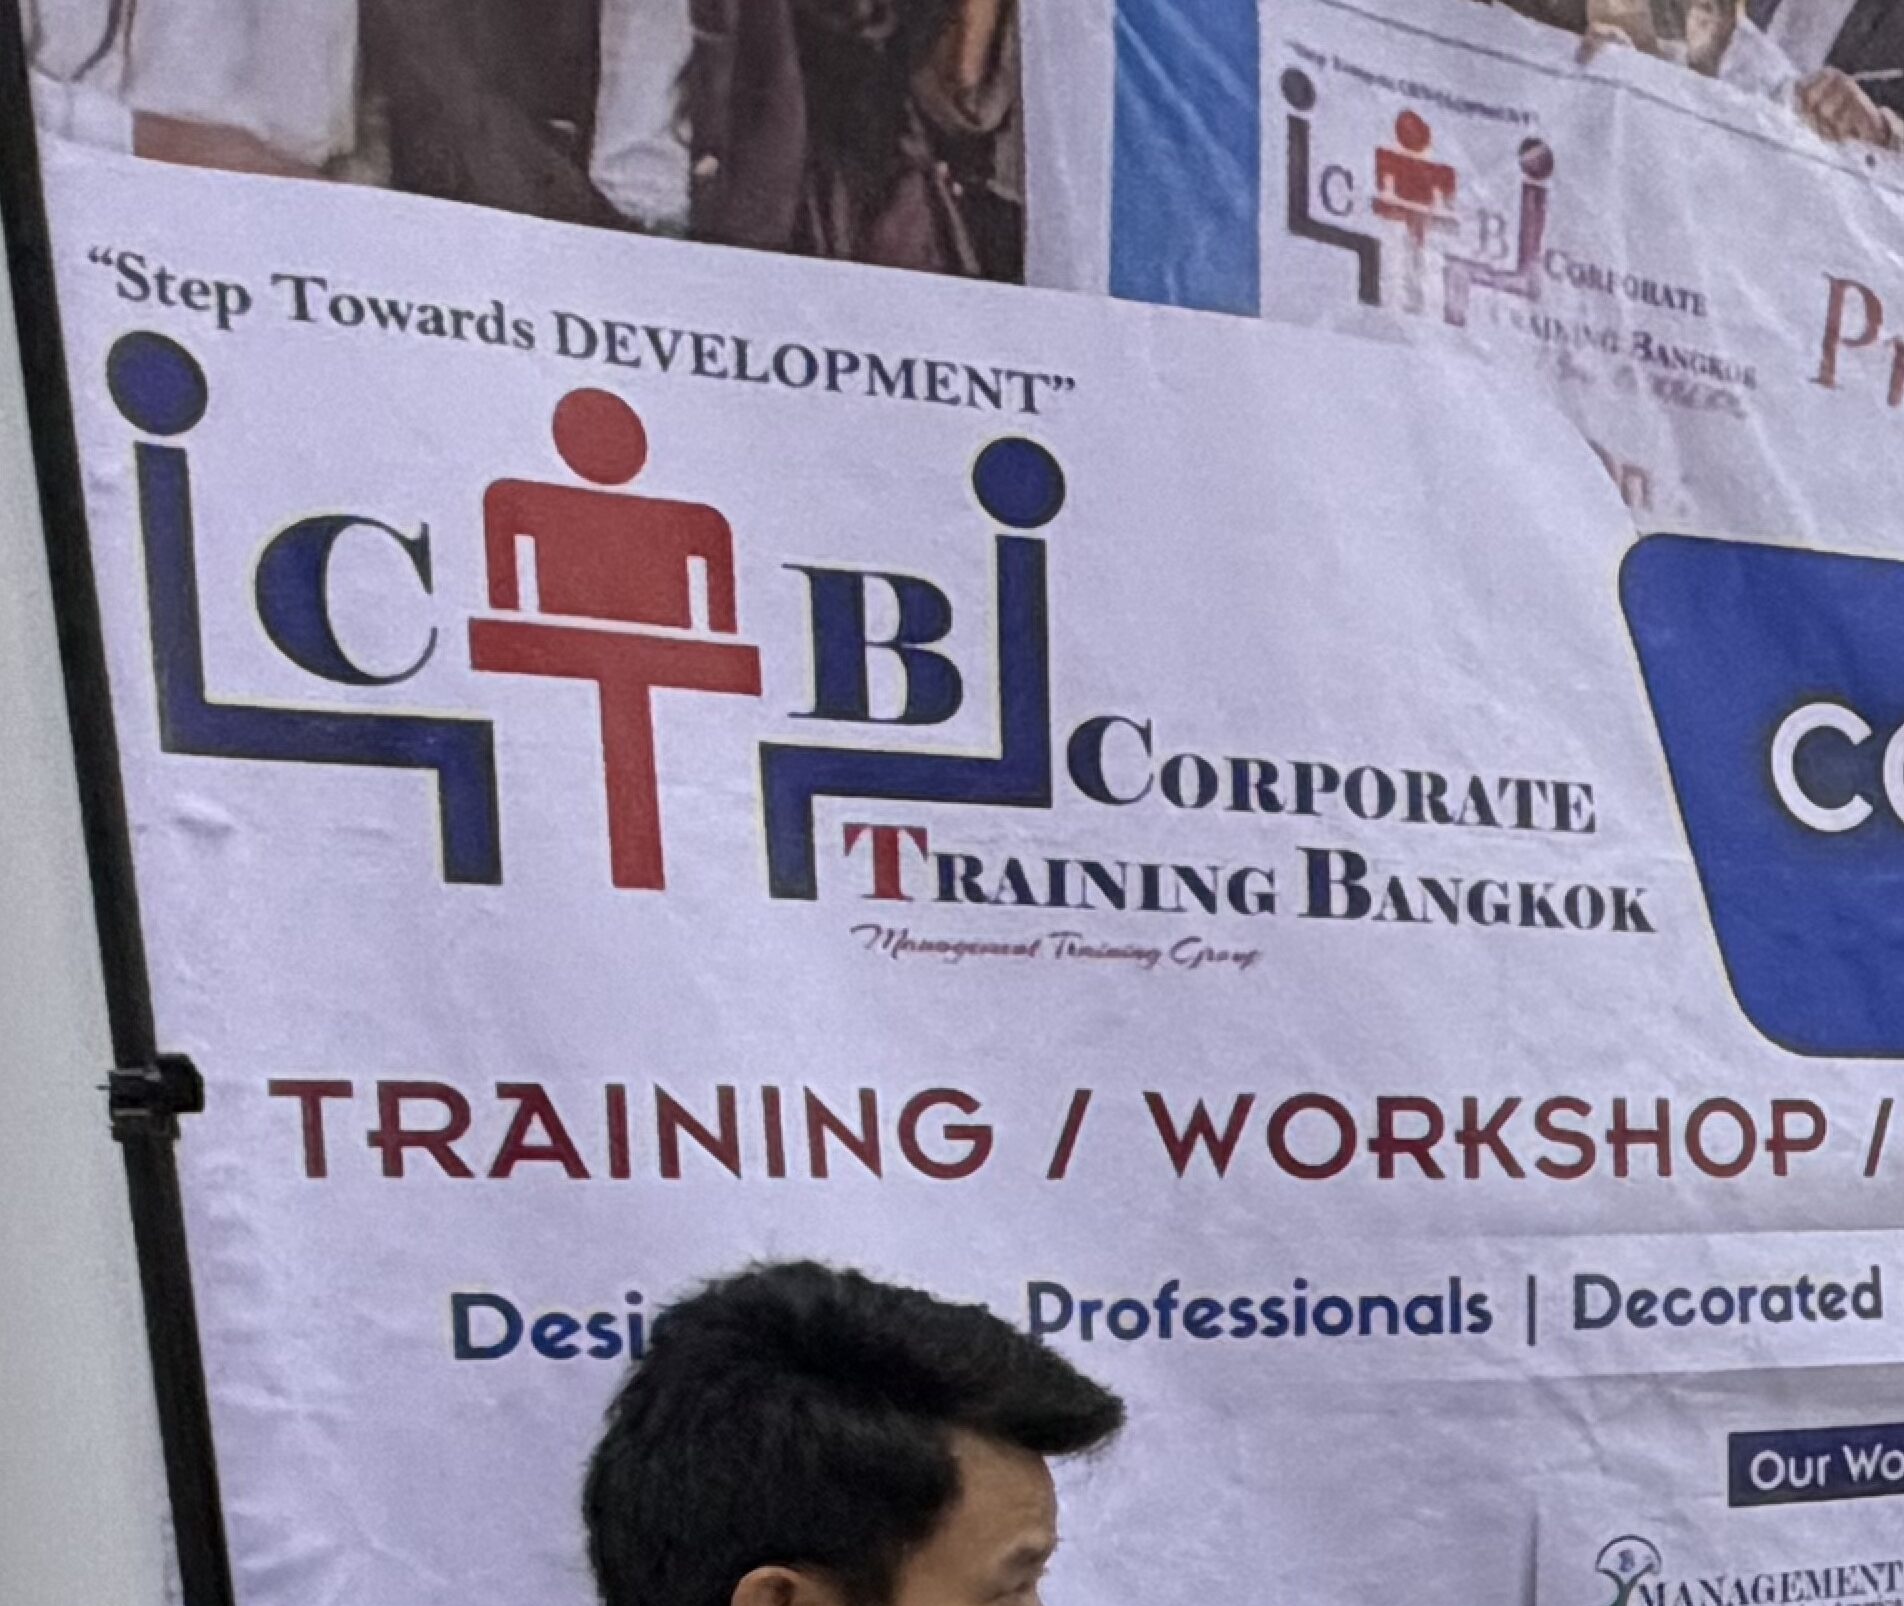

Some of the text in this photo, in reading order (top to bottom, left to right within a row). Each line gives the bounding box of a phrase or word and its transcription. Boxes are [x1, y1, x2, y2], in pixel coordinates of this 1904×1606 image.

[271, 273, 536, 351] Towards
[552, 312, 1076, 414] DEVELOPMENT”
[1066, 716, 1597, 833] CORPORATE
[843, 822, 1657, 933] TRAINING BANGKOK
[266, 1078, 995, 1180] TRAINING
[1143, 1091, 1827, 1180] WORKSHOP
[451, 1290, 652, 1361] Desi
[1026, 1277, 1494, 1347] Professionals
[1572, 1264, 1882, 1330] Decorated
[1750, 1449, 1830, 1490] Our
